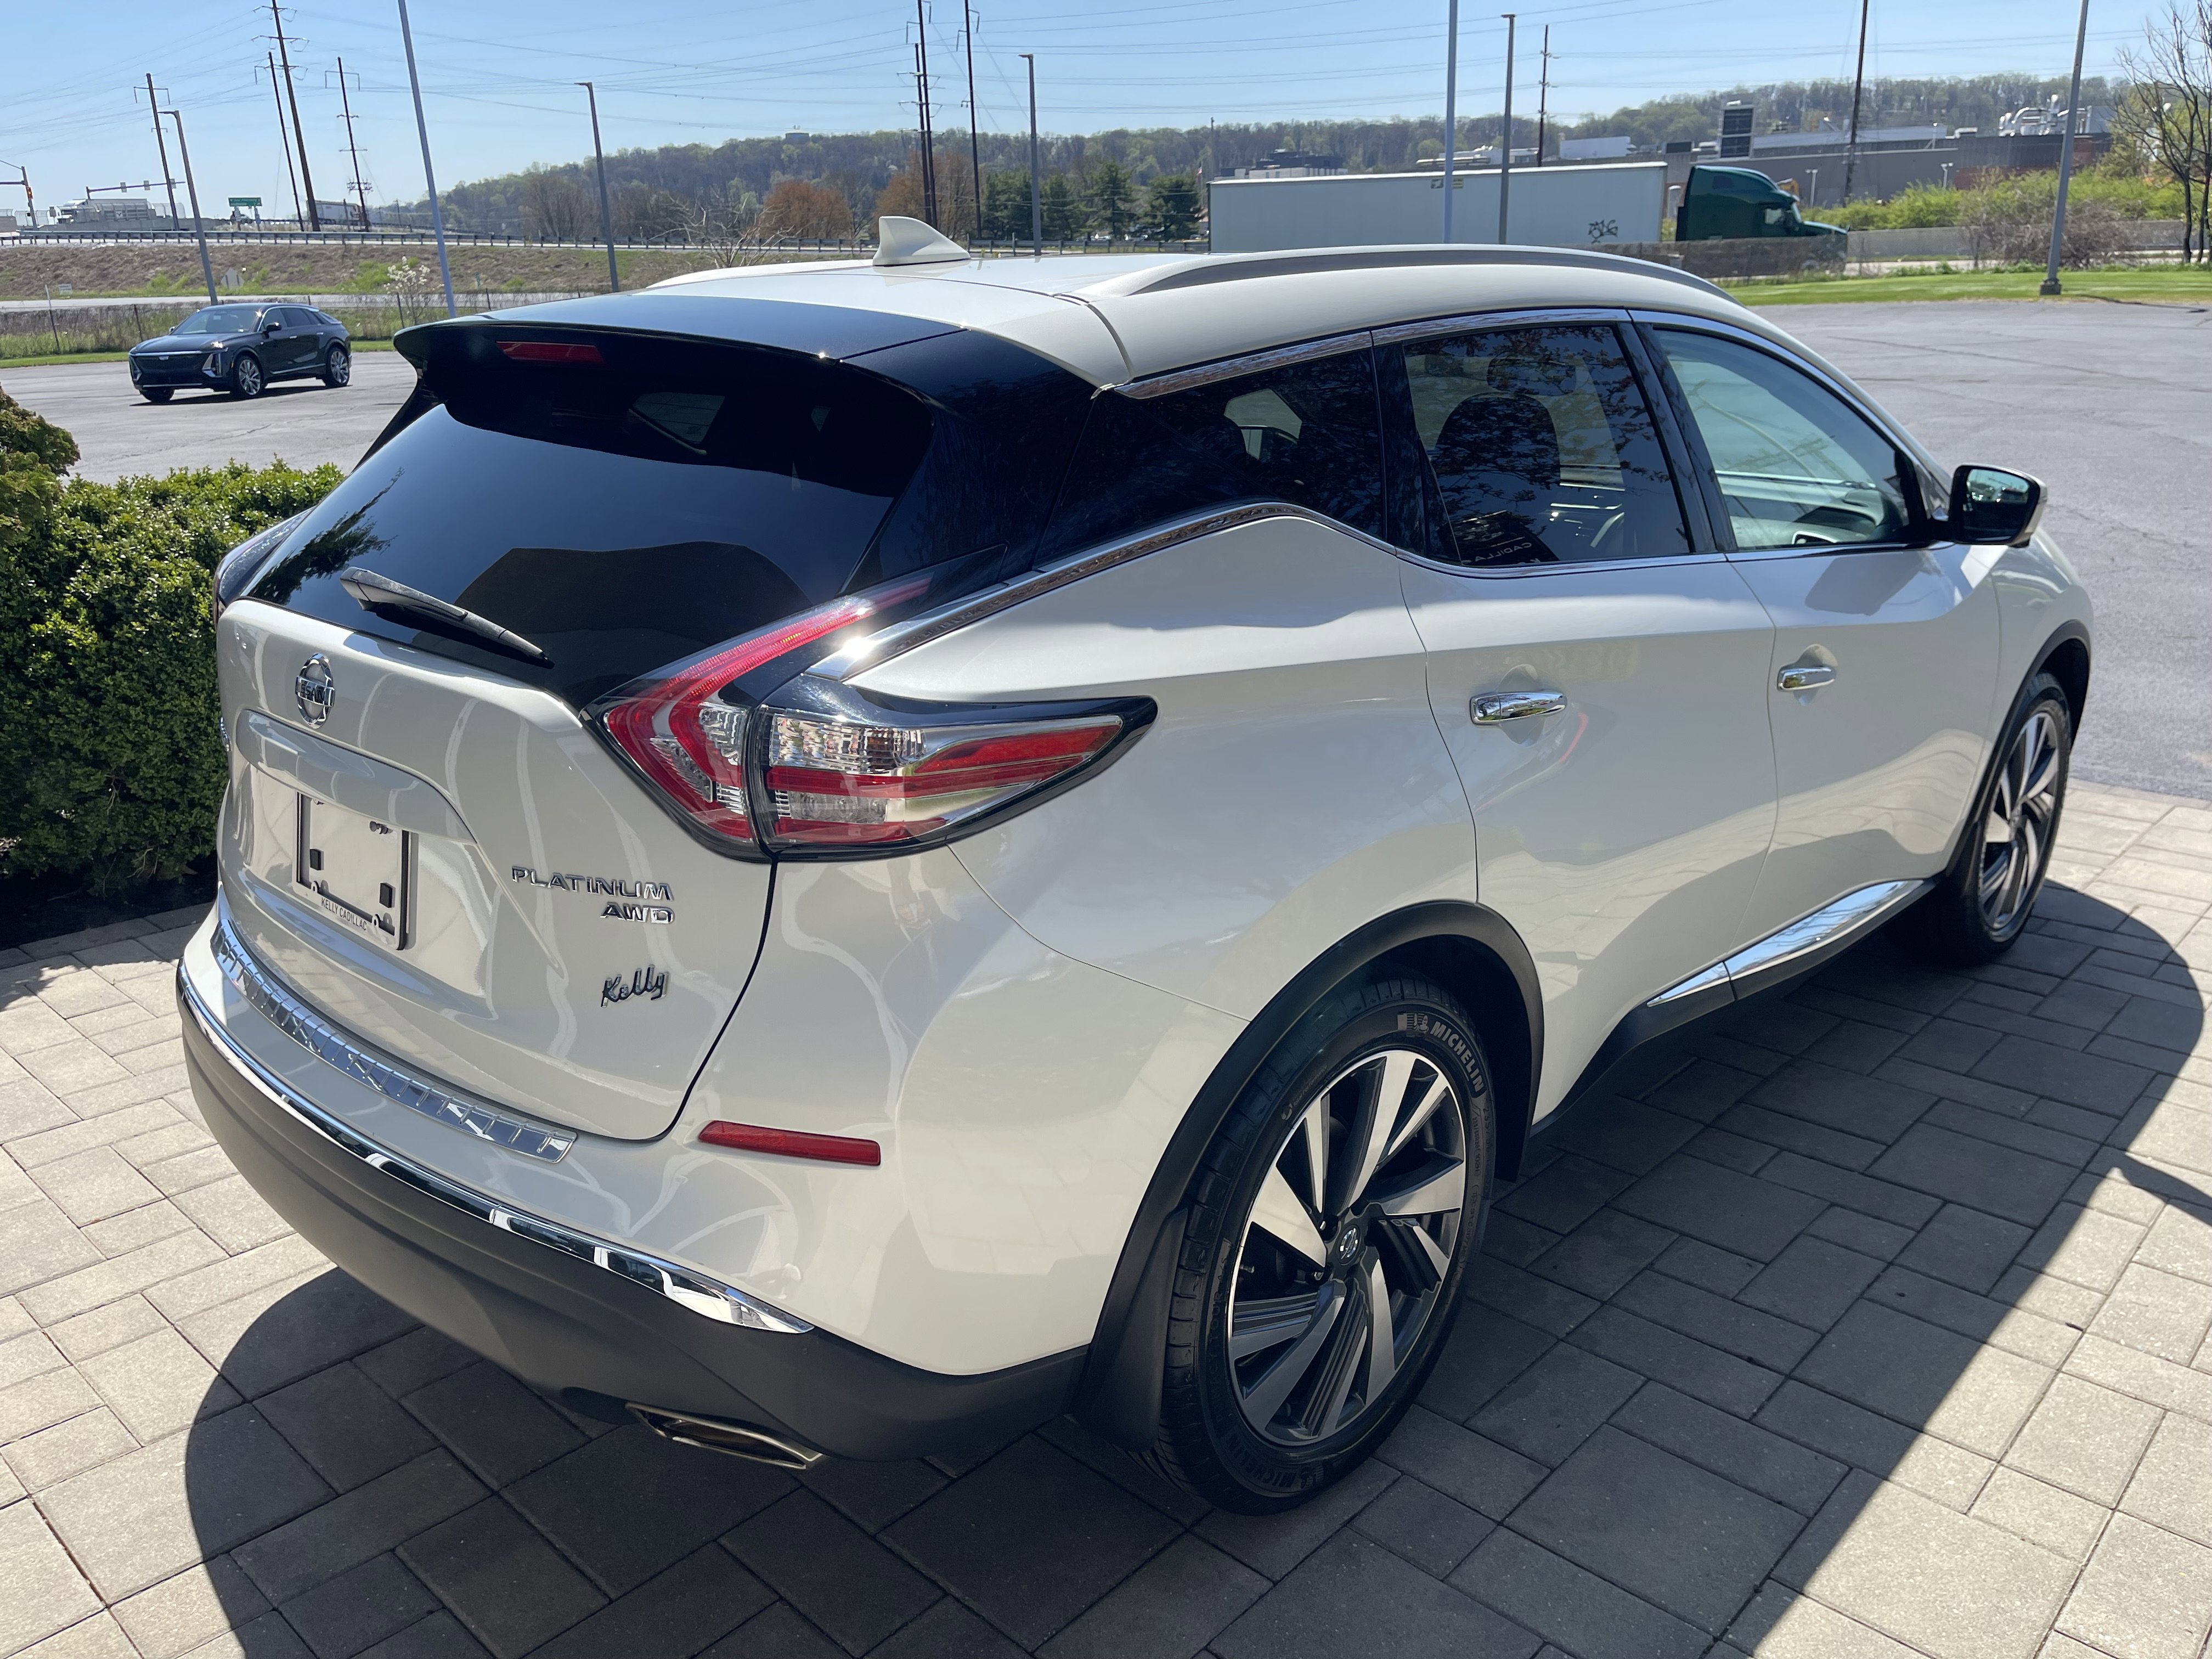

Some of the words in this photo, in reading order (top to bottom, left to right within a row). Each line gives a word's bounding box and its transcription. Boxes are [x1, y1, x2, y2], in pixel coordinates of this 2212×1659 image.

[511, 865, 674, 901] PLATINUM
[321, 896, 338, 915] KELLY
[339, 907, 367, 931] CADILLAC
[600, 901, 675, 924] AWD
[600, 964, 669, 1008] Kelly
[1430, 1021, 1485, 1093] MICHELIN
